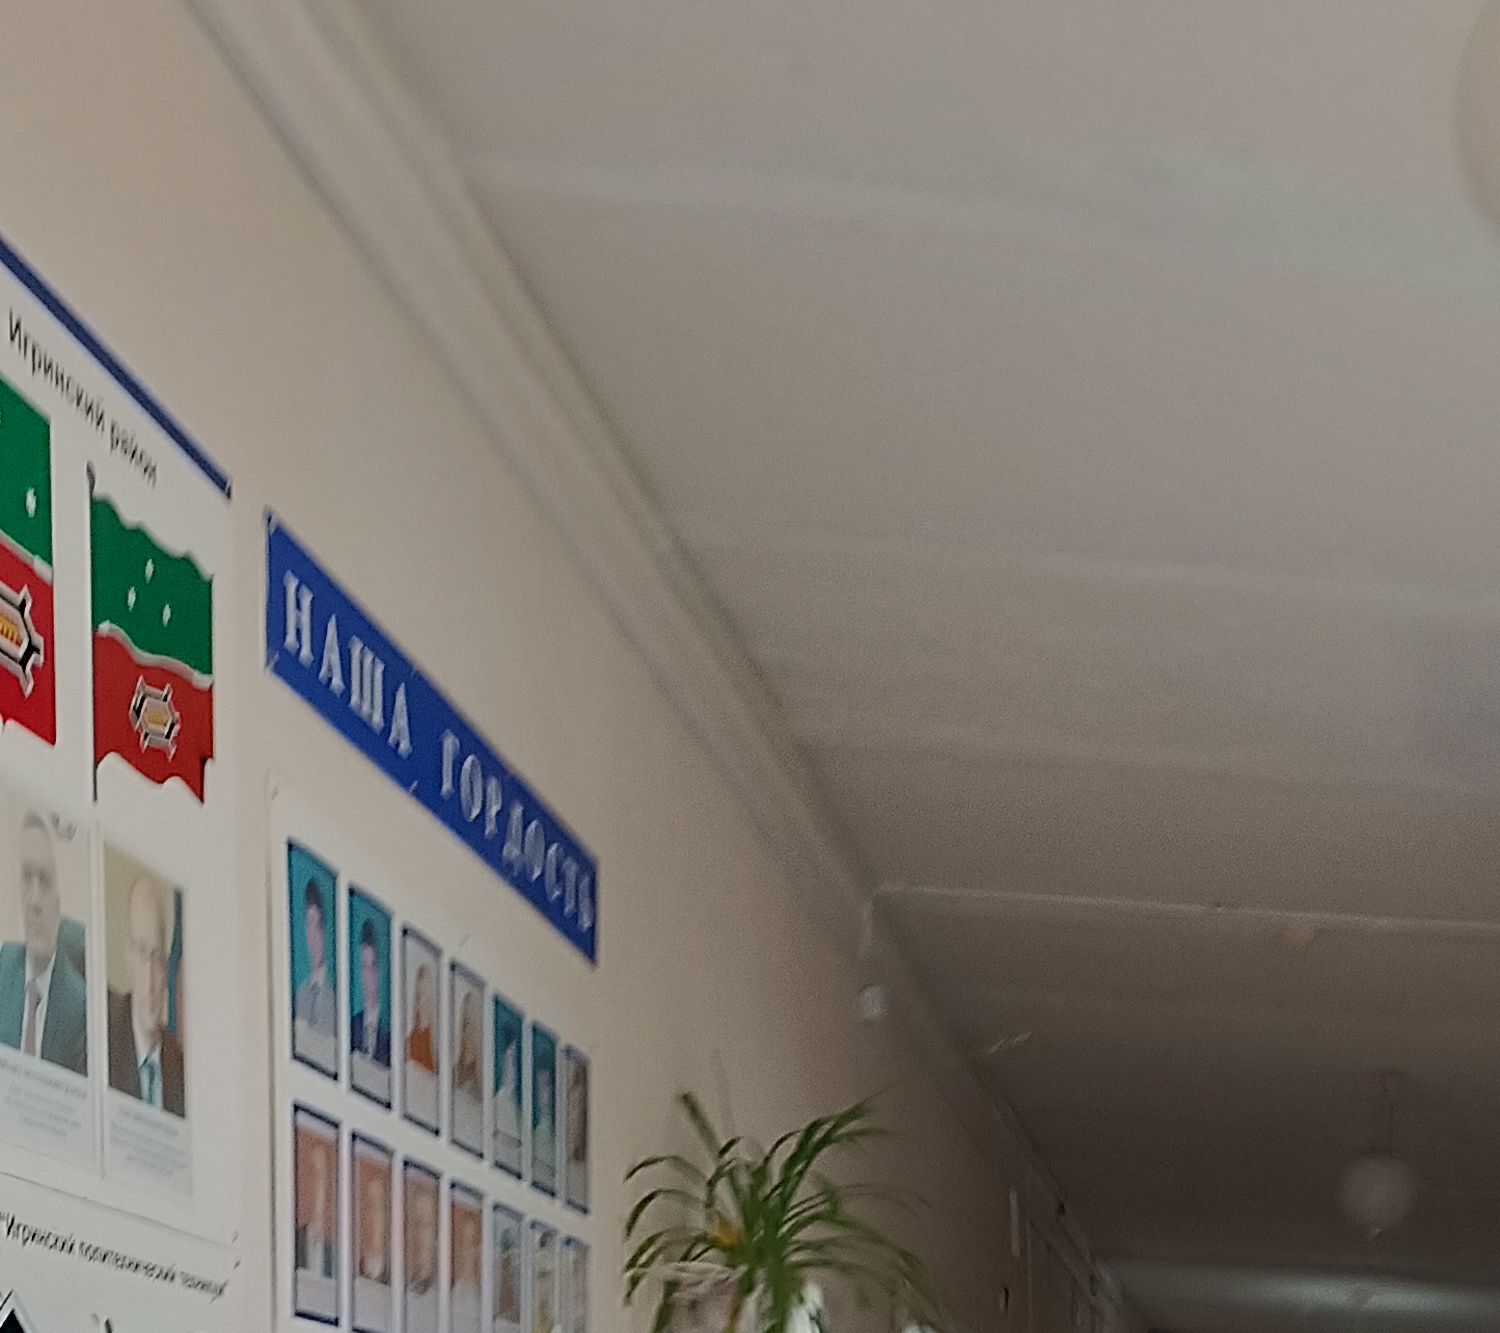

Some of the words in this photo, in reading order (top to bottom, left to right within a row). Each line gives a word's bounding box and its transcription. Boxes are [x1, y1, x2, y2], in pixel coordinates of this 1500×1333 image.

[9, 306, 105, 433] Игринский
[283, 569, 413, 759] НАША
[440, 728, 594, 932] ГОРДОСТЬ
